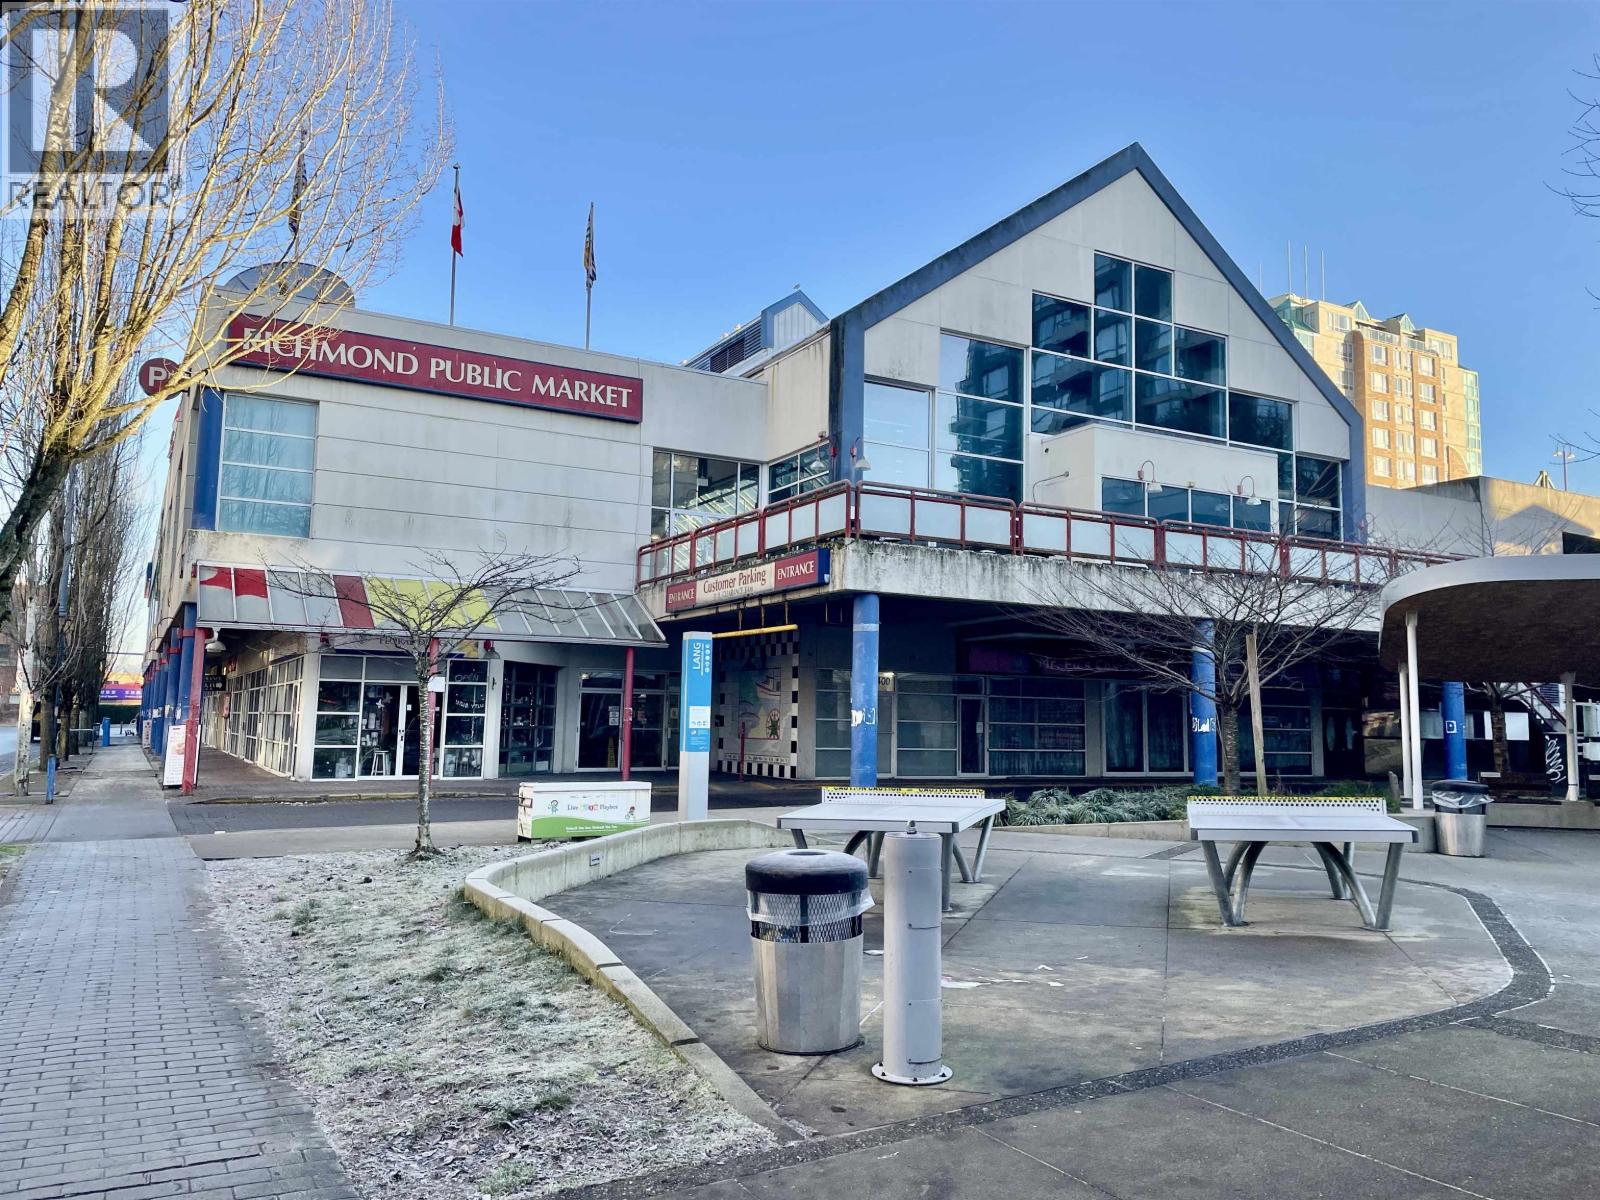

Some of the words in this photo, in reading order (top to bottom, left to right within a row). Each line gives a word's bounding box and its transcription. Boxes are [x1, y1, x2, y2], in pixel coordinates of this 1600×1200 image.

[243, 328, 419, 375] RICHMOND
[429, 357, 522, 392] PUBLIC
[531, 374, 632, 408] MARKET
[668, 588, 695, 604] ENTRANCE
[703, 577, 737, 594] Customer
[738, 568, 766, 586] Parking
[777, 560, 815, 580] ENTRANCE
[692, 642, 701, 670] LANG
